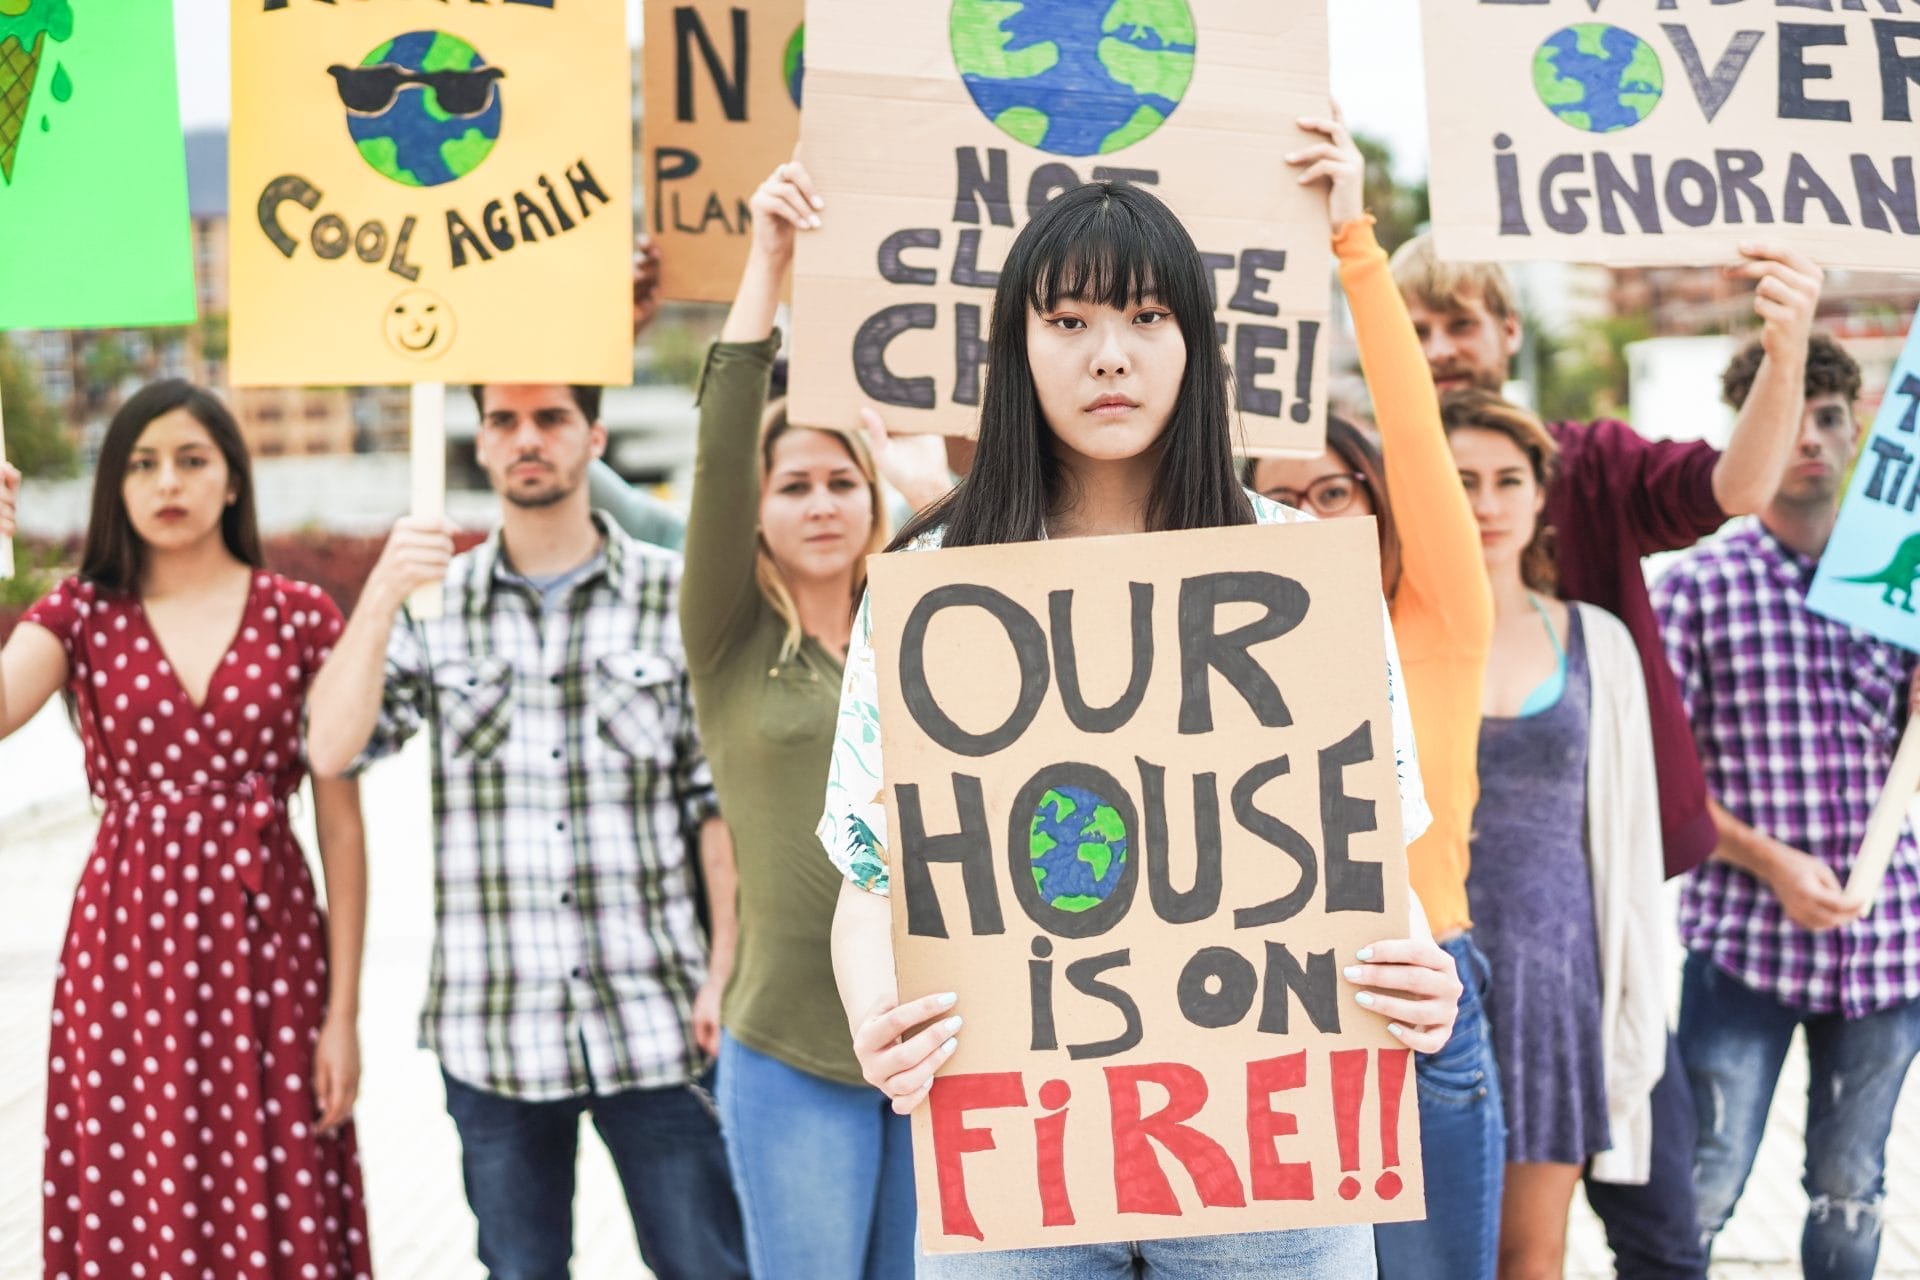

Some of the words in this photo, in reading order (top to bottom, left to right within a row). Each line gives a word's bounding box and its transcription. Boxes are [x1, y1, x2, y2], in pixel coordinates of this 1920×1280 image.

[257, 174, 423, 282] COOL
[878, 228, 1286, 317] CLTE
[853, 302, 1320, 424] CHE!
[899, 571, 1310, 757] OUR
[894, 719, 1385, 939] HOUSE
[1177, 940, 1342, 1035] ON
